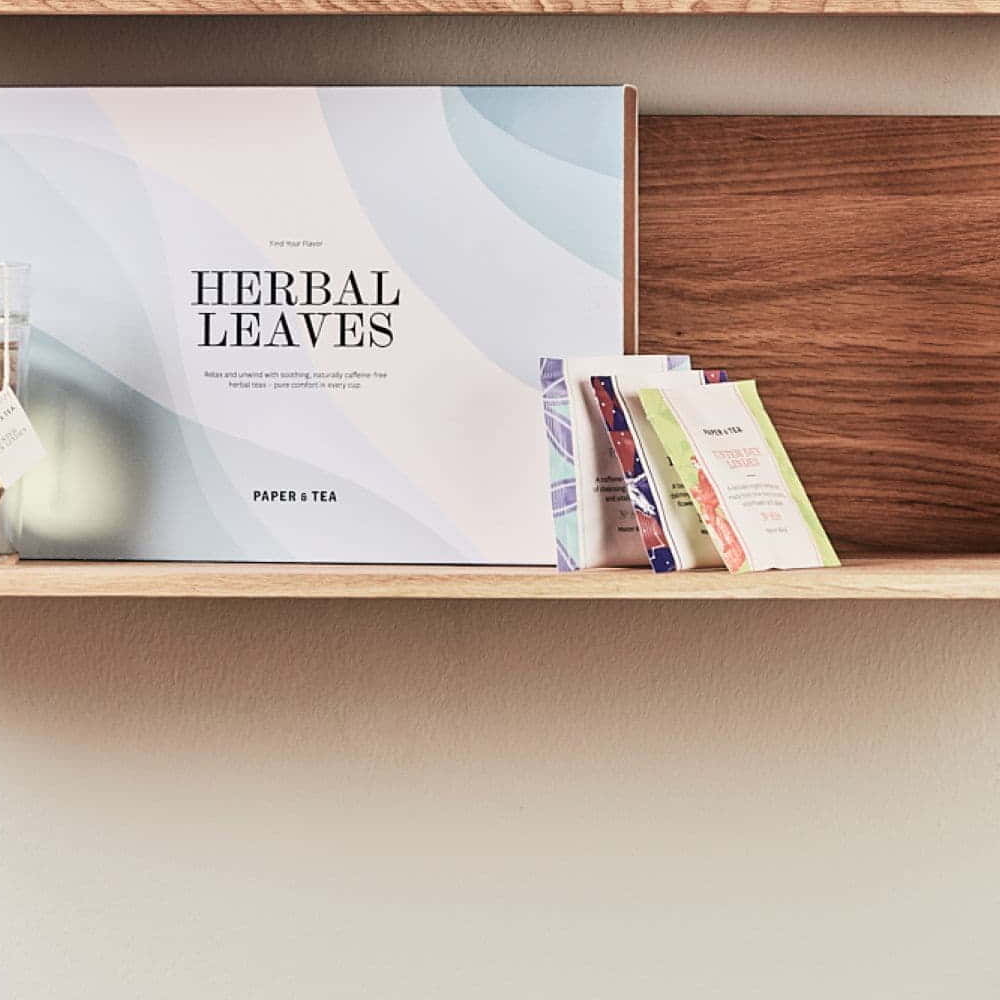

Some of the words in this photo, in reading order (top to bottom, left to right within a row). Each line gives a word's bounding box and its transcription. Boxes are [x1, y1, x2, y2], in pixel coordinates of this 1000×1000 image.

[269, 239, 284, 248] Find
[285, 239, 300, 248] Your
[302, 239, 323, 248] Flavor
[190, 269, 401, 306] HERBAL
[197, 311, 394, 348] LEAVES
[223, 370, 237, 378] and
[264, 370, 279, 378] with
[703, 428, 723, 436] PAPER
[729, 426, 743, 434] TEA
[252, 489, 297, 502] PAPER
[311, 489, 337, 502] TEA
